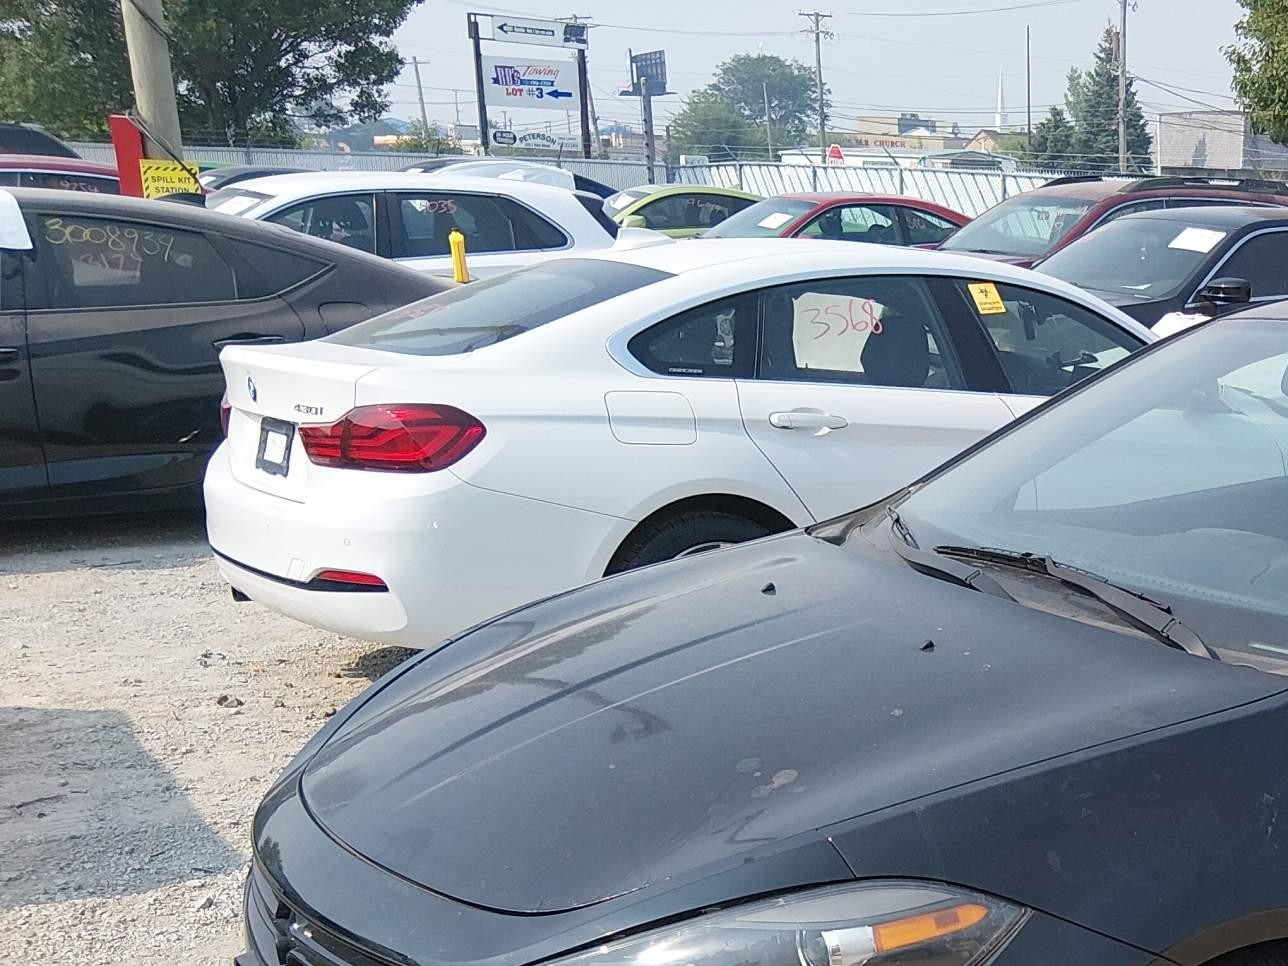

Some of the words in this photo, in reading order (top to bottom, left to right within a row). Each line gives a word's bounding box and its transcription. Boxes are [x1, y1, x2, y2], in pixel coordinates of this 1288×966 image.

[516, 66, 560, 80] Towing
[506, 88, 524, 97] LOT
[526, 87, 544, 99] #3
[519, 132, 557, 145] PETERSON
[873, 140, 906, 148] CHURCH
[150, 175, 176, 184] SPILL
[177, 176, 191, 184] KIT
[154, 186, 190, 194] STATION
[45, 218, 174, 263] 3008934
[800, 299, 884, 340] 3568
